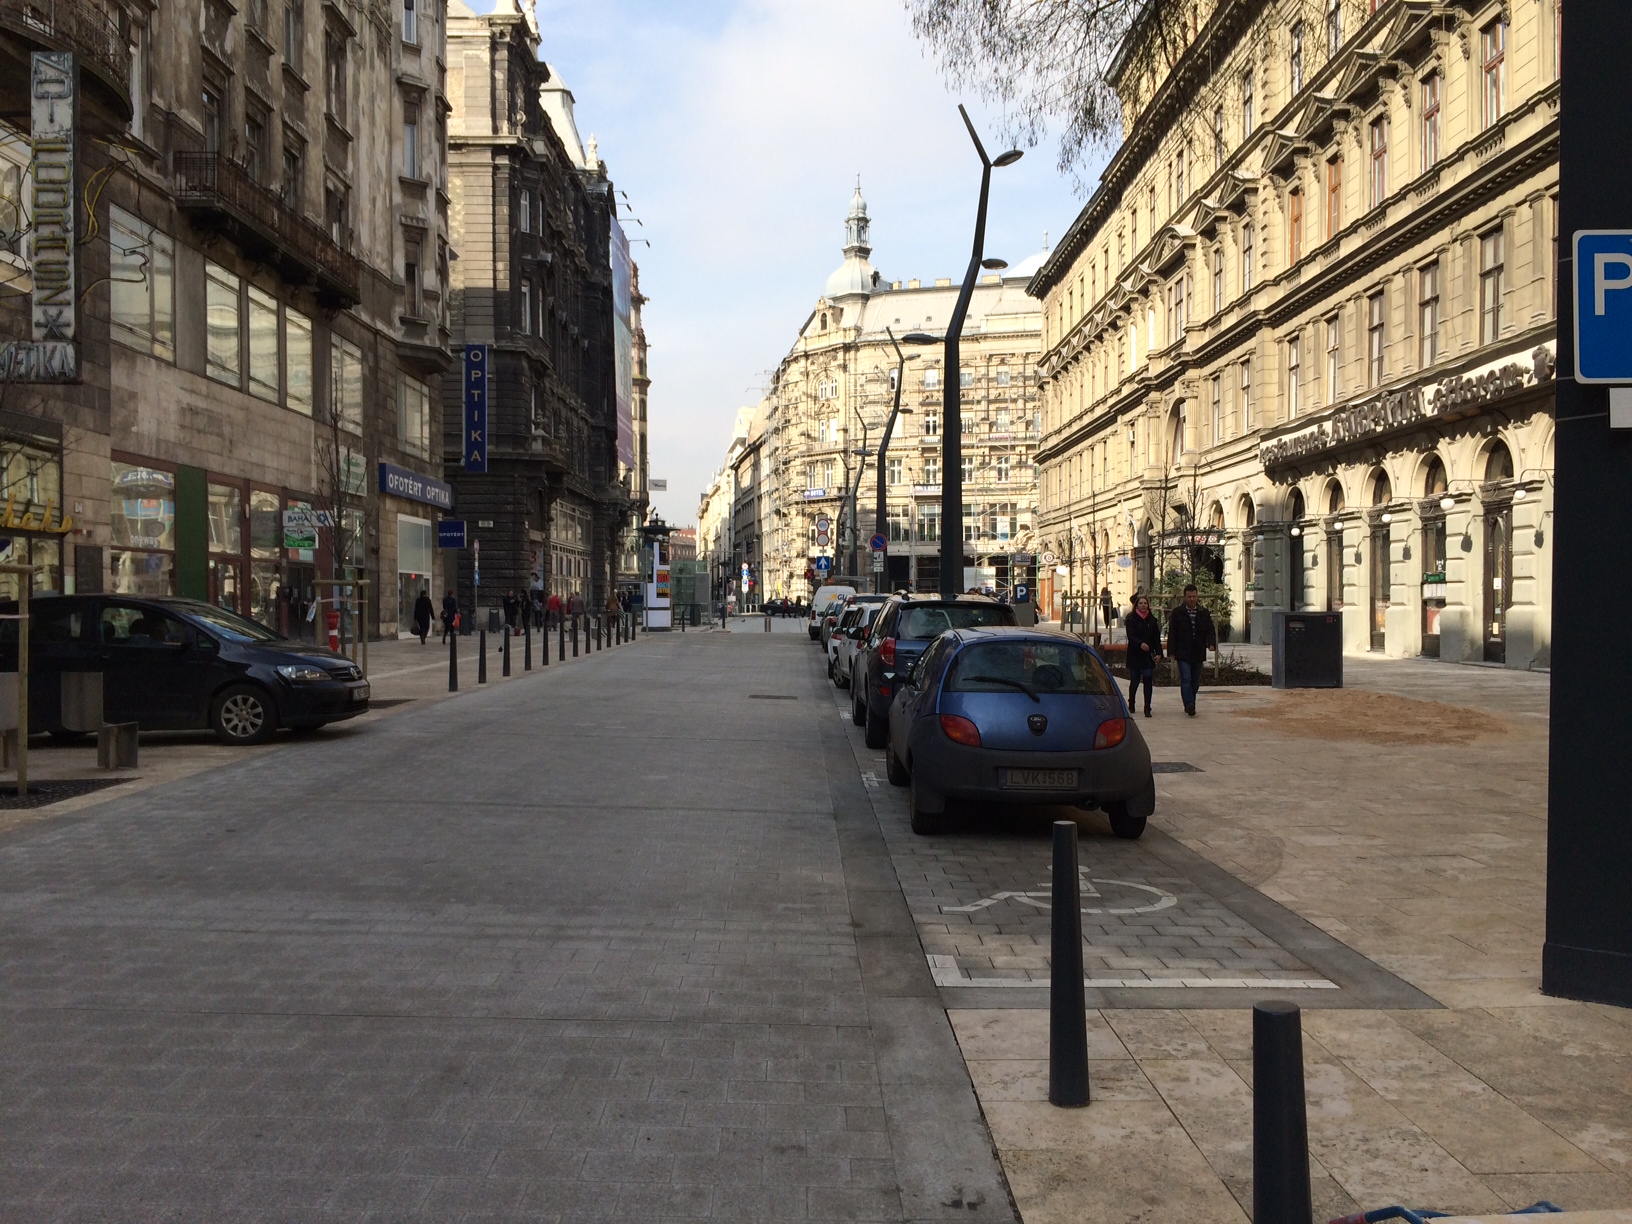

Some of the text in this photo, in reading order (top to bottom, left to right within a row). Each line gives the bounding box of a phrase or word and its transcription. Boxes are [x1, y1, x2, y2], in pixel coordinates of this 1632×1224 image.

[1594, 253, 1632, 316] P
[469, 350, 483, 462] OPTIKA
[388, 474, 422, 497] OFOTÉRT
[426, 486, 450, 505] OPTIKA
[1016, 586, 1027, 599] P
